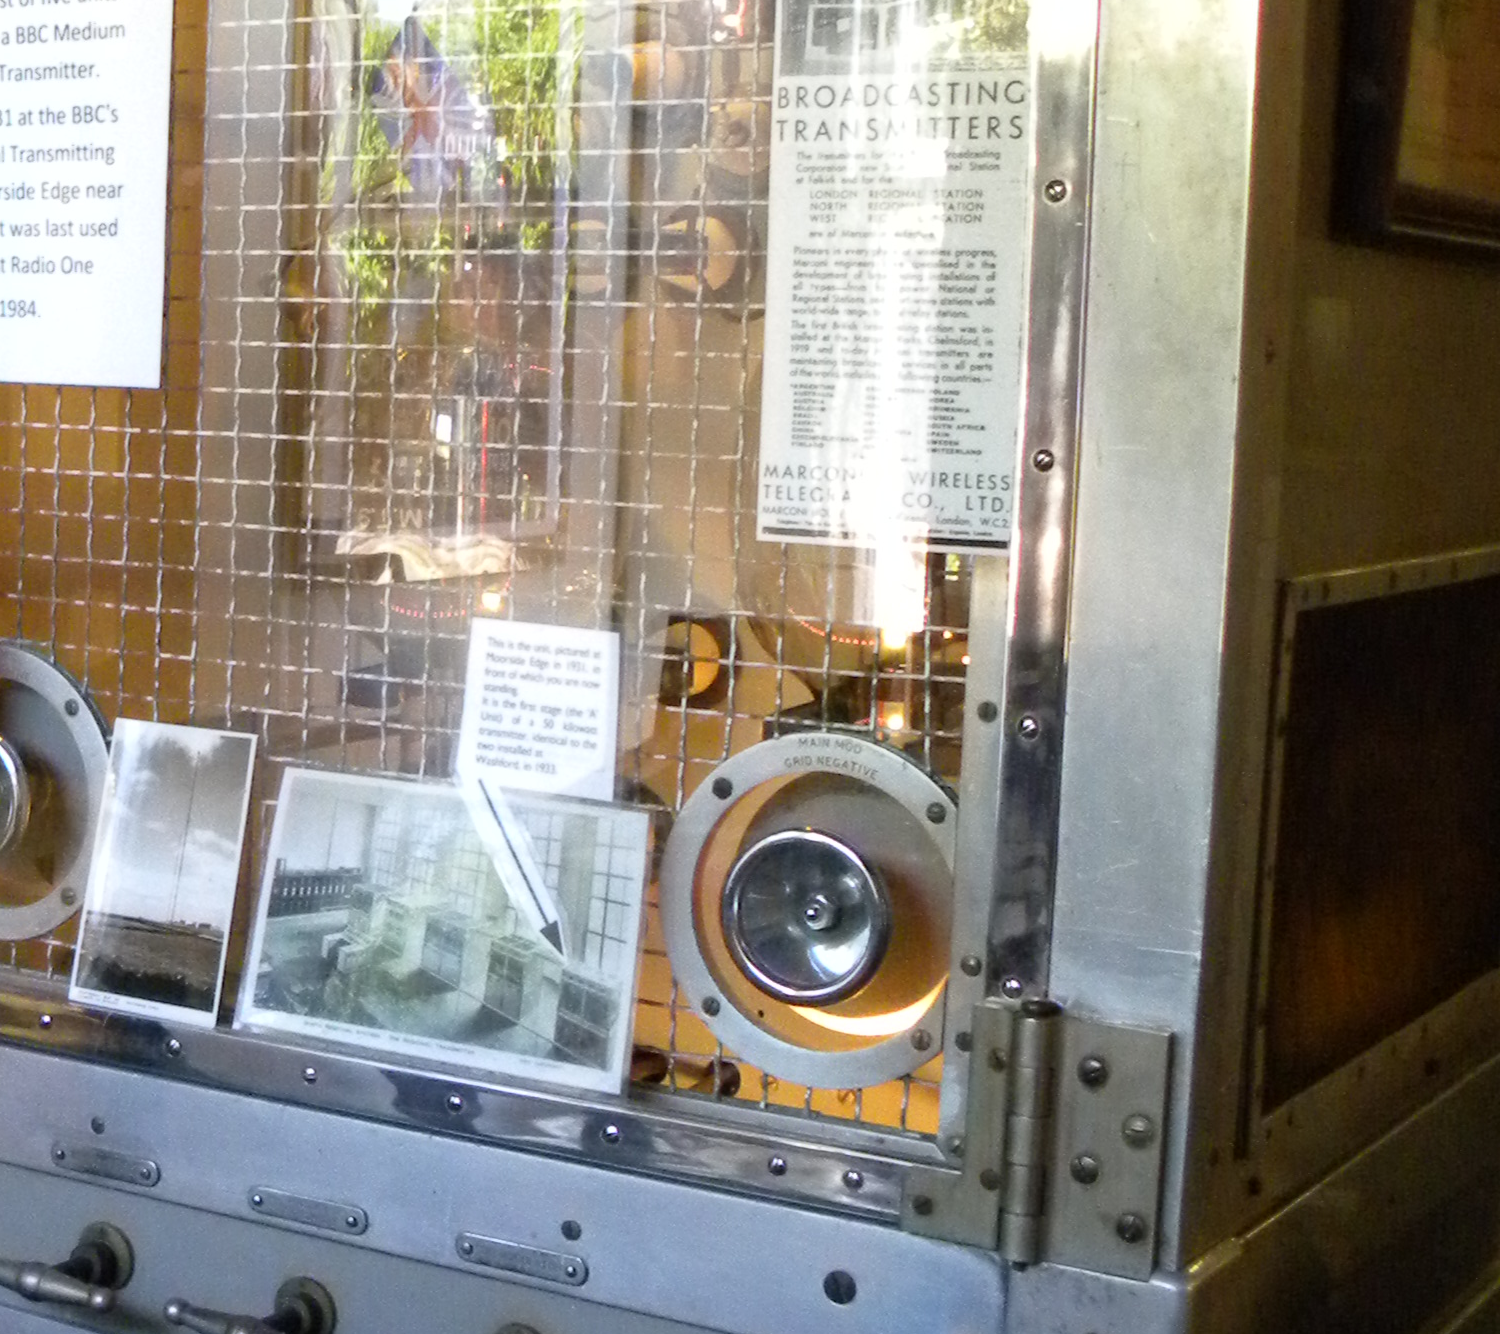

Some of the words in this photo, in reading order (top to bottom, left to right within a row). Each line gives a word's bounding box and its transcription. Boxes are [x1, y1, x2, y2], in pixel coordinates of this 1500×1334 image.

[1, 31, 10, 46] a
[16, 25, 48, 45] BBC
[54, 21, 125, 42] Medium
[777, 79, 1027, 110] BROADCASTING
[18, 110, 33, 126] at
[38, 107, 66, 125] the
[71, 104, 119, 125] BBC's
[10, 144, 115, 165] Transmitting
[40, 182, 80, 205] Edge
[86, 184, 123, 199] near
[10, 223, 41, 237] was
[45, 218, 74, 238] last
[79, 218, 118, 237] used
[11, 256, 56, 275] Radio
[61, 257, 94, 275] One
[0, 300, 41, 318] 1984.
[764, 464, 863, 482] MARCON
[909, 472, 1010, 491] WIRELESS
[764, 484, 851, 502] TELEGA
[966, 496, 1010, 513] LTD.
[799, 738, 831, 747] MAIN
[835, 739, 863, 755] MOD
[784, 756, 813, 768] GRID
[816, 756, 879, 780] NEGATIVE
